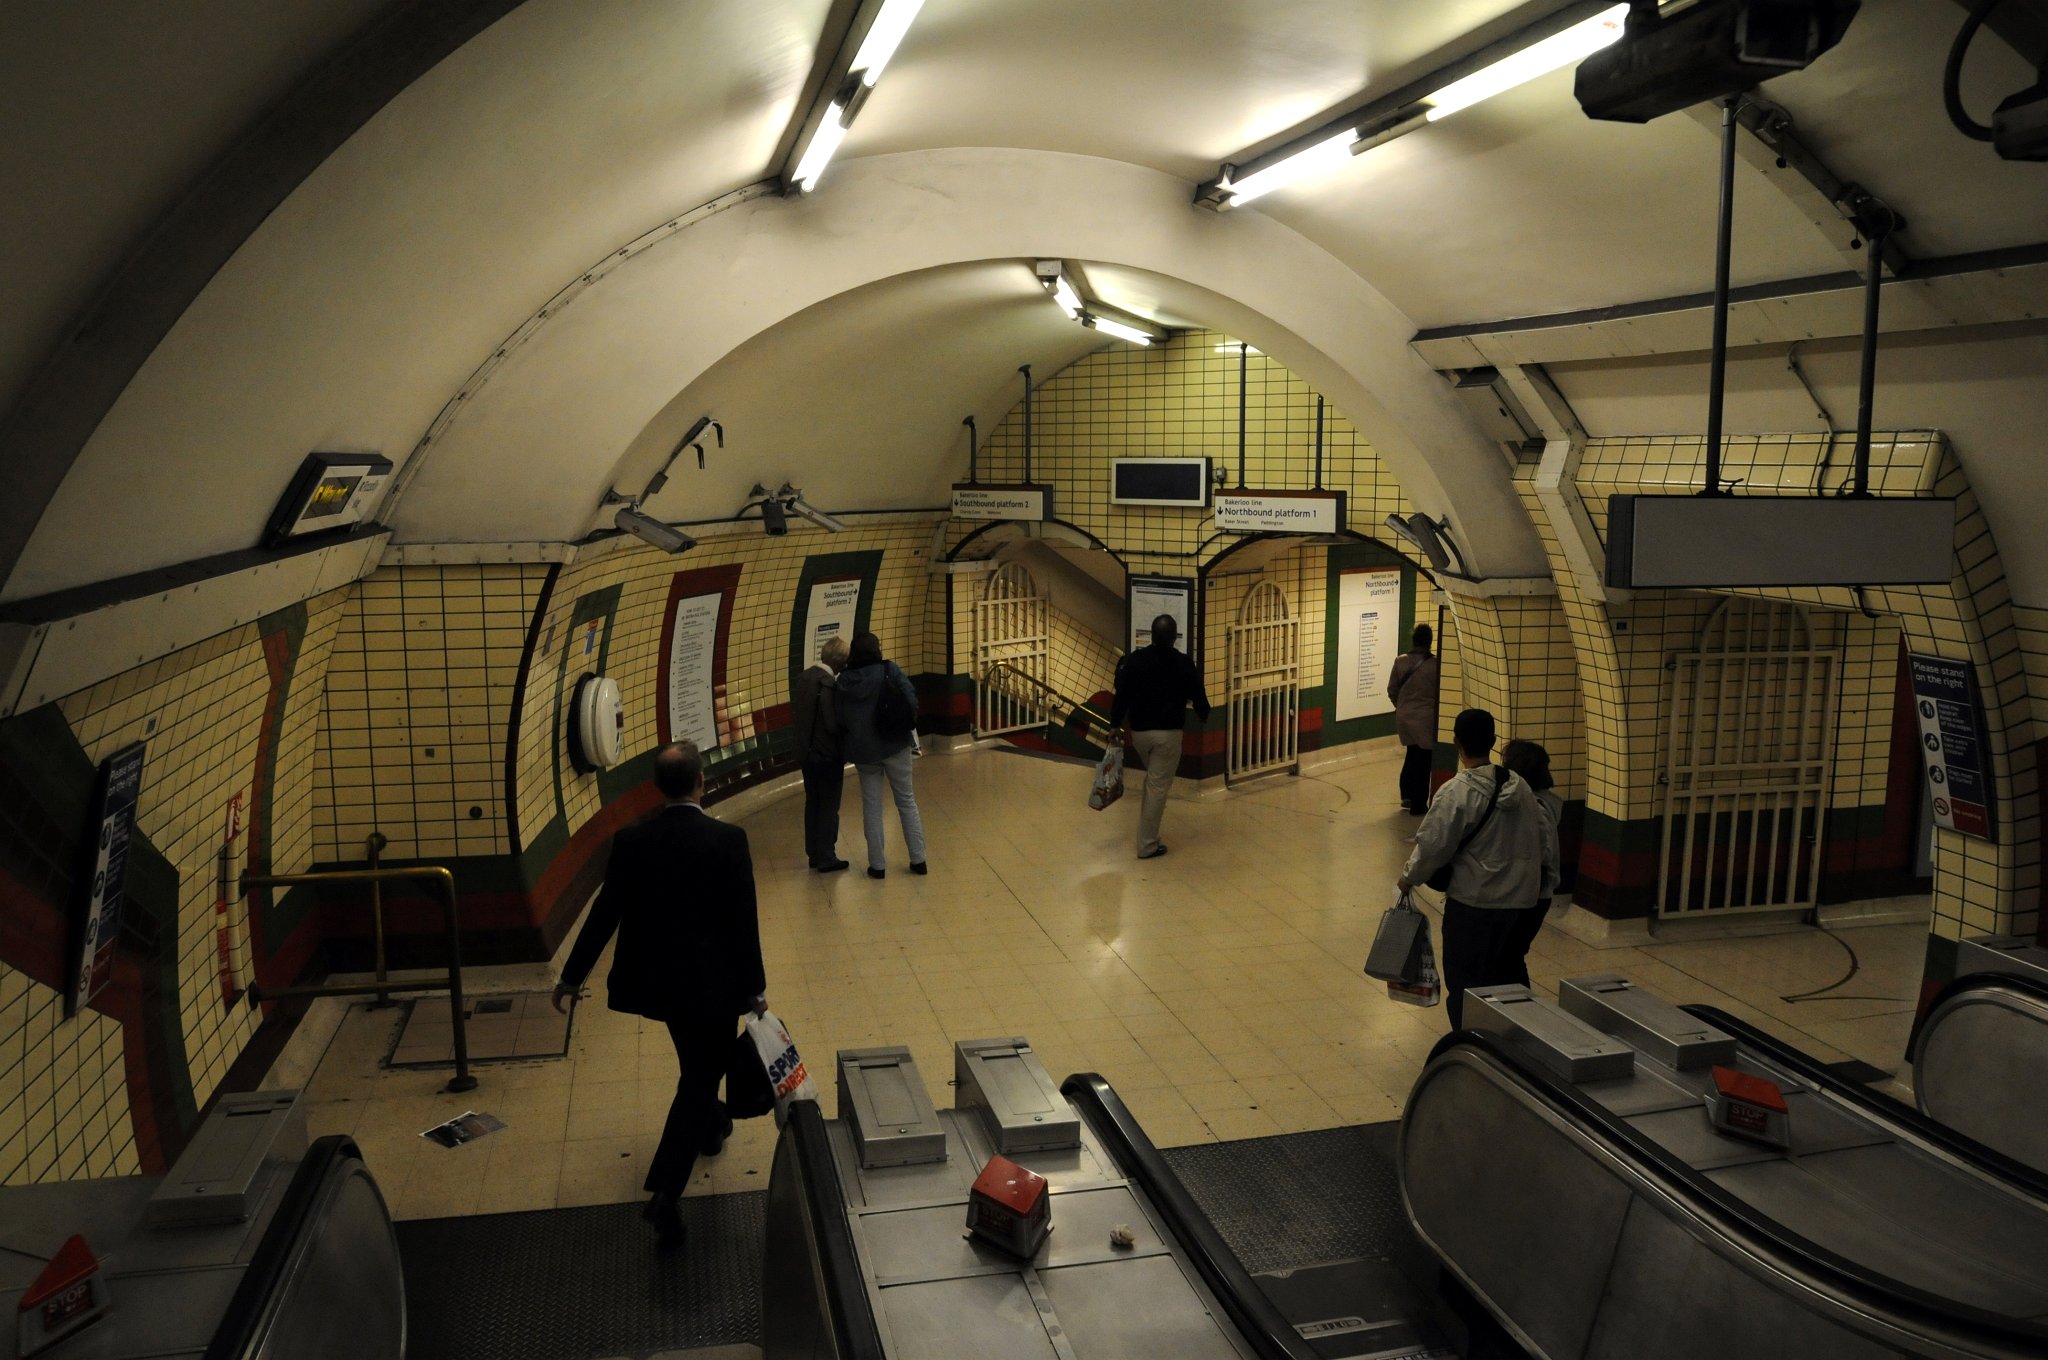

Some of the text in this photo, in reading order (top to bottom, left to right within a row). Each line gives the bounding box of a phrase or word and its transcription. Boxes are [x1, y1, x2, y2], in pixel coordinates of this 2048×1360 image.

[960, 500, 996, 508] Southbound
[996, 501, 1024, 509] platform
[1224, 498, 1250, 506] Bakerloo
[1224, 507, 1273, 517] Northbound
[1274, 508, 1311, 519] platform
[824, 590, 853, 599] Southbound
[1371, 589, 1390, 597] platform
[826, 599, 847, 608] platform
[1912, 660, 1966, 679] Please stand
[1915, 673, 1965, 689] on the right
[111, 765, 128, 782] Please
[107, 785, 116, 797] on
[126, 771, 138, 788] right
[778, 1063, 807, 1098] DIRECT
[1731, 1103, 1765, 1119] STOP
